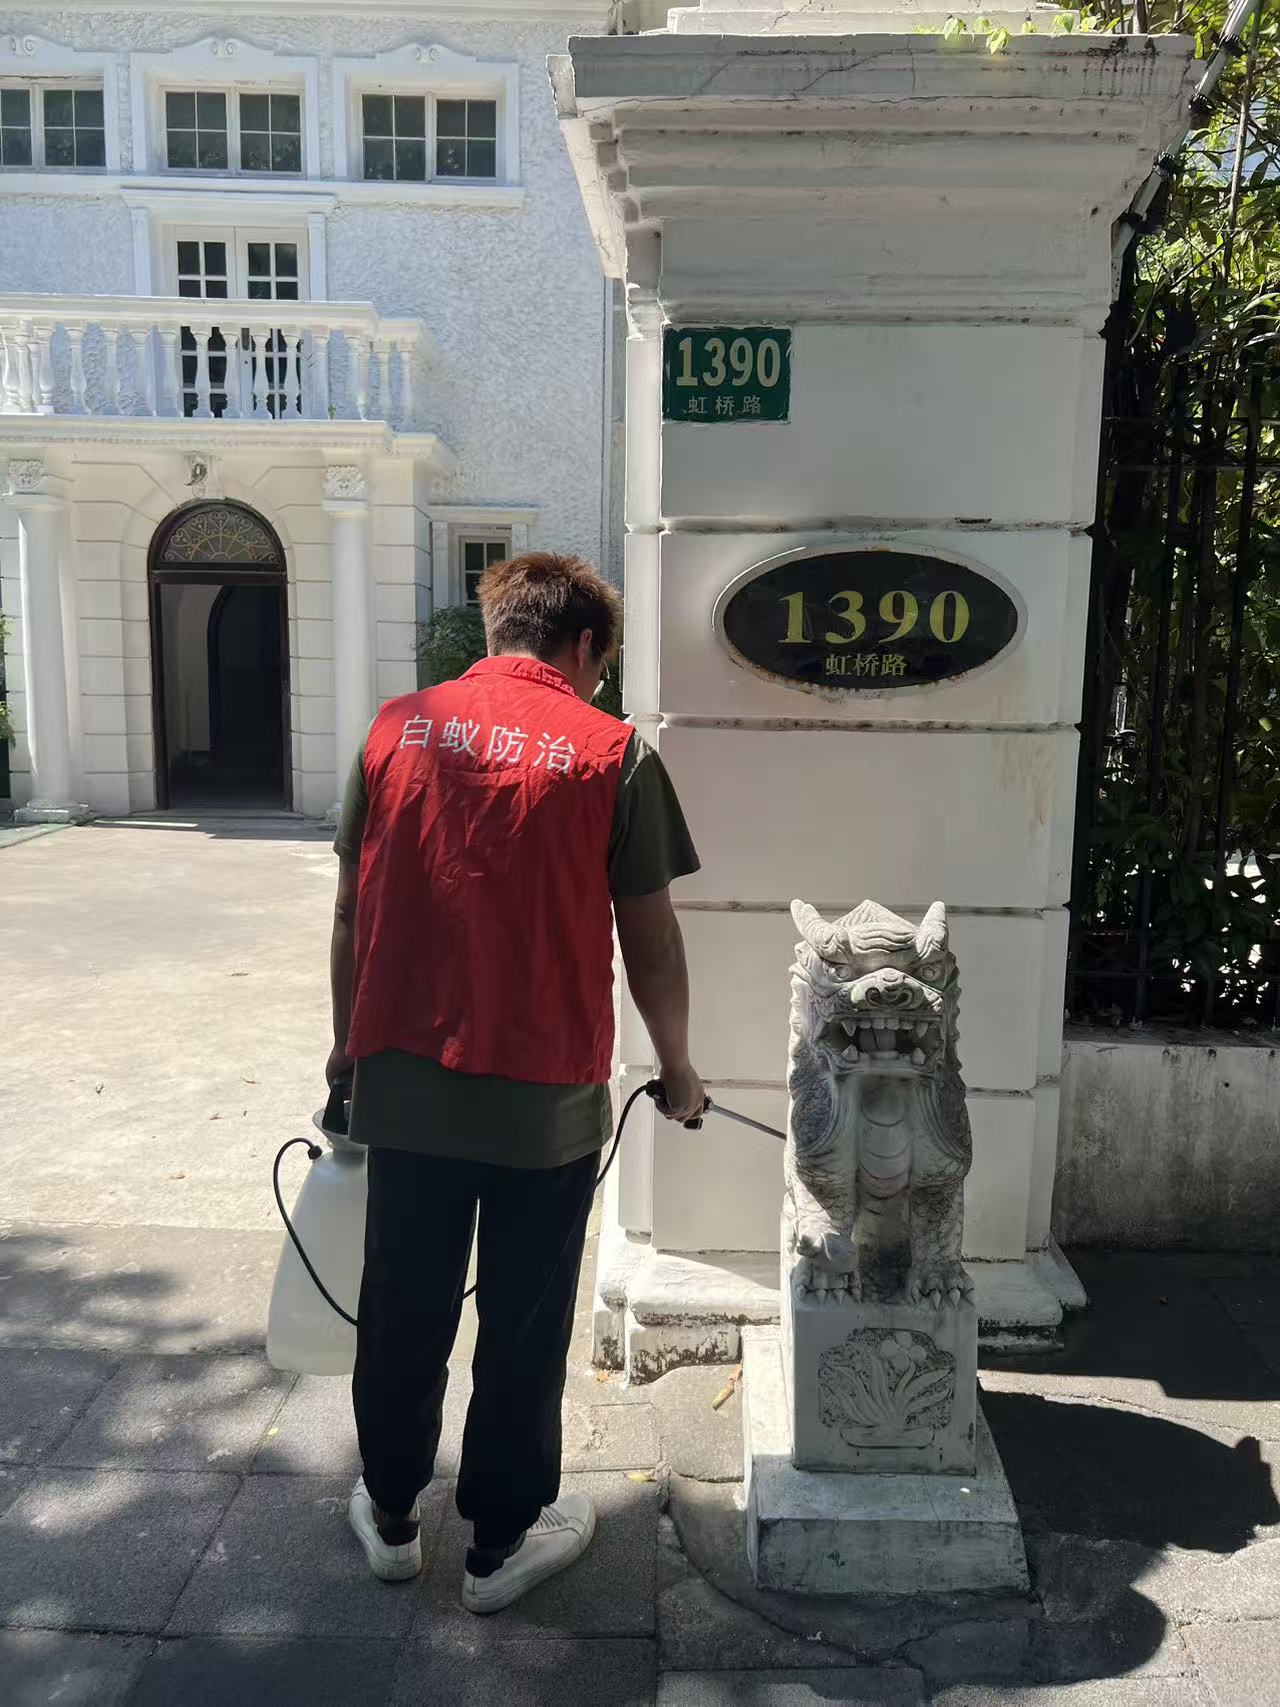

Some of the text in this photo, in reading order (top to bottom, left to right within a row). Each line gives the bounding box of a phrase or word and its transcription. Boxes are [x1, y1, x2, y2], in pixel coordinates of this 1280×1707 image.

[676, 337, 781, 387] 1390
[688, 395, 761, 416] 虹桥路
[778, 590, 970, 644] 1390
[826, 653, 907, 676] 虹桥路
[400, 714, 576, 774] 白蚁防治
